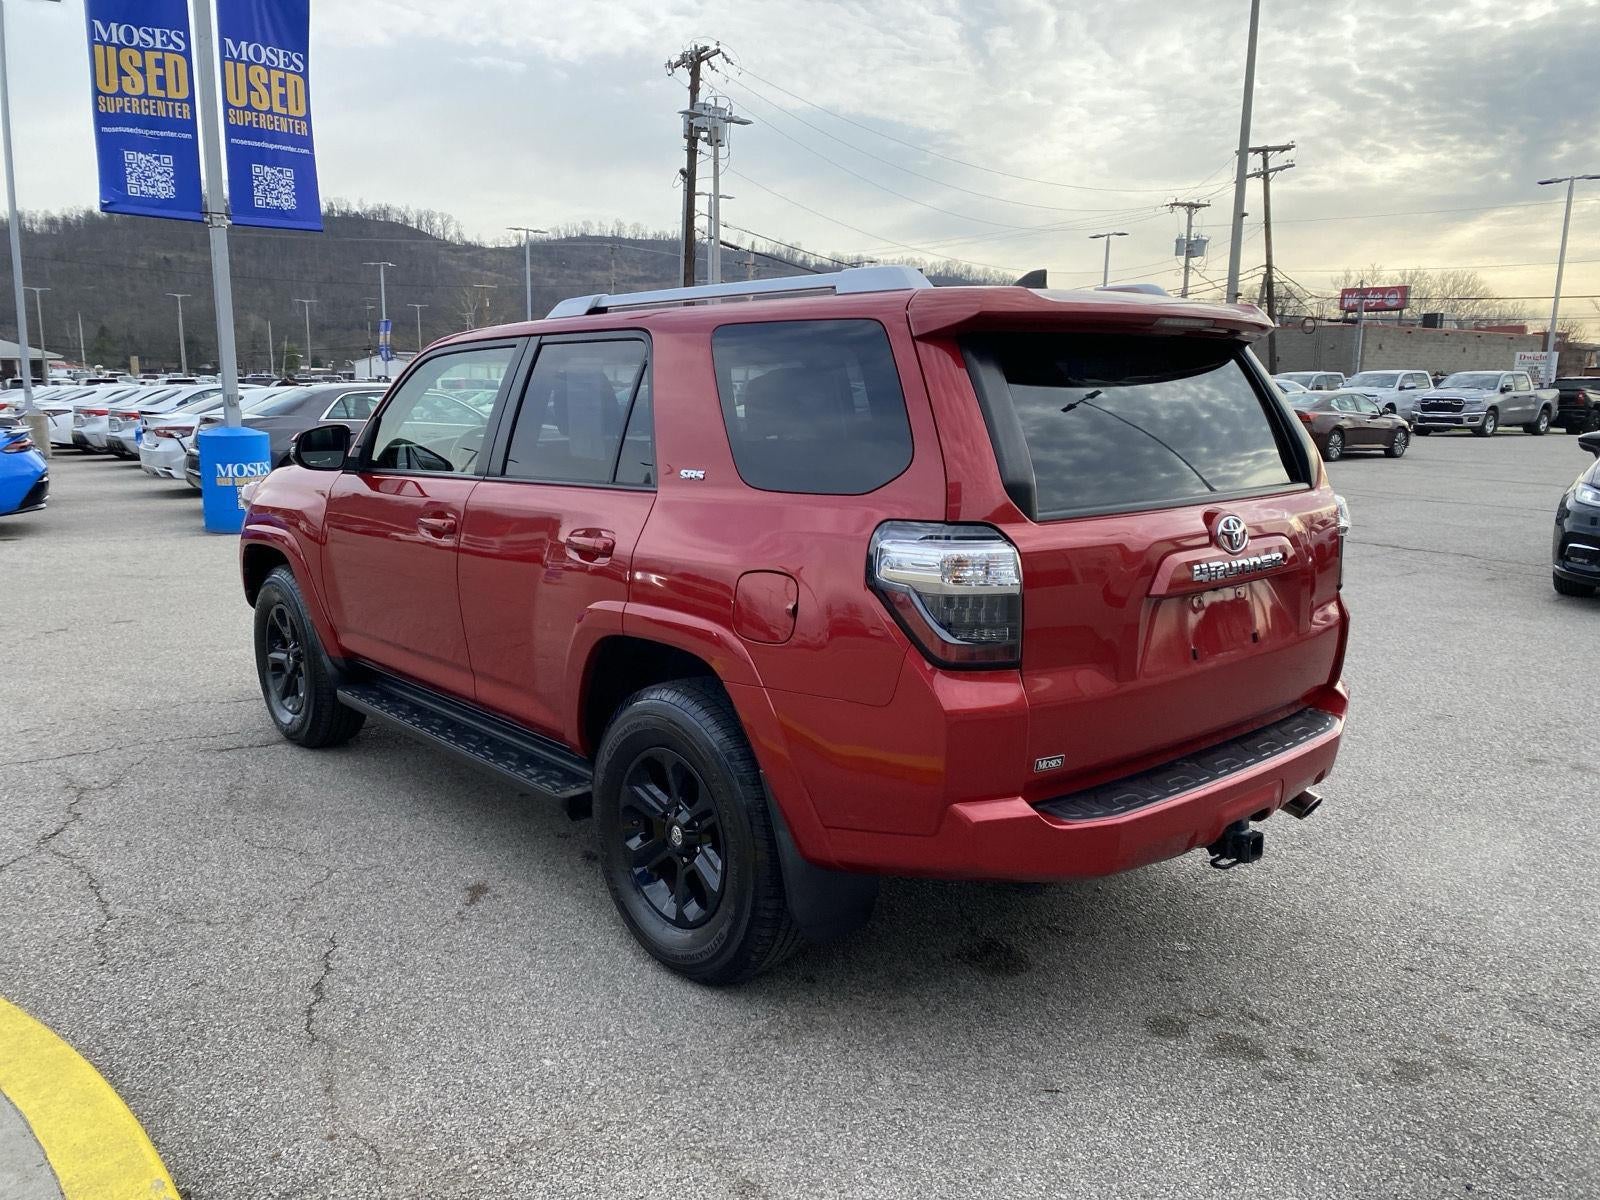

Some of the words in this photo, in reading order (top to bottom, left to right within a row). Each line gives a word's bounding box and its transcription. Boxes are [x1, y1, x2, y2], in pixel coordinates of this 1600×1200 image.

[92, 19, 186, 51] MOSES
[224, 37, 304, 73] MOSES
[94, 44, 189, 100] USED
[224, 60, 307, 117] USED
[97, 95, 191, 120] SUPERCENTER
[101, 126, 192, 139] mosesusedsupercenter.com
[228, 108, 308, 137] SUPERCENTER
[230, 137, 310, 155] mosesusedsupercenter.com
[215, 461, 271, 477] MOSES
[680, 469, 705, 480] SR5
